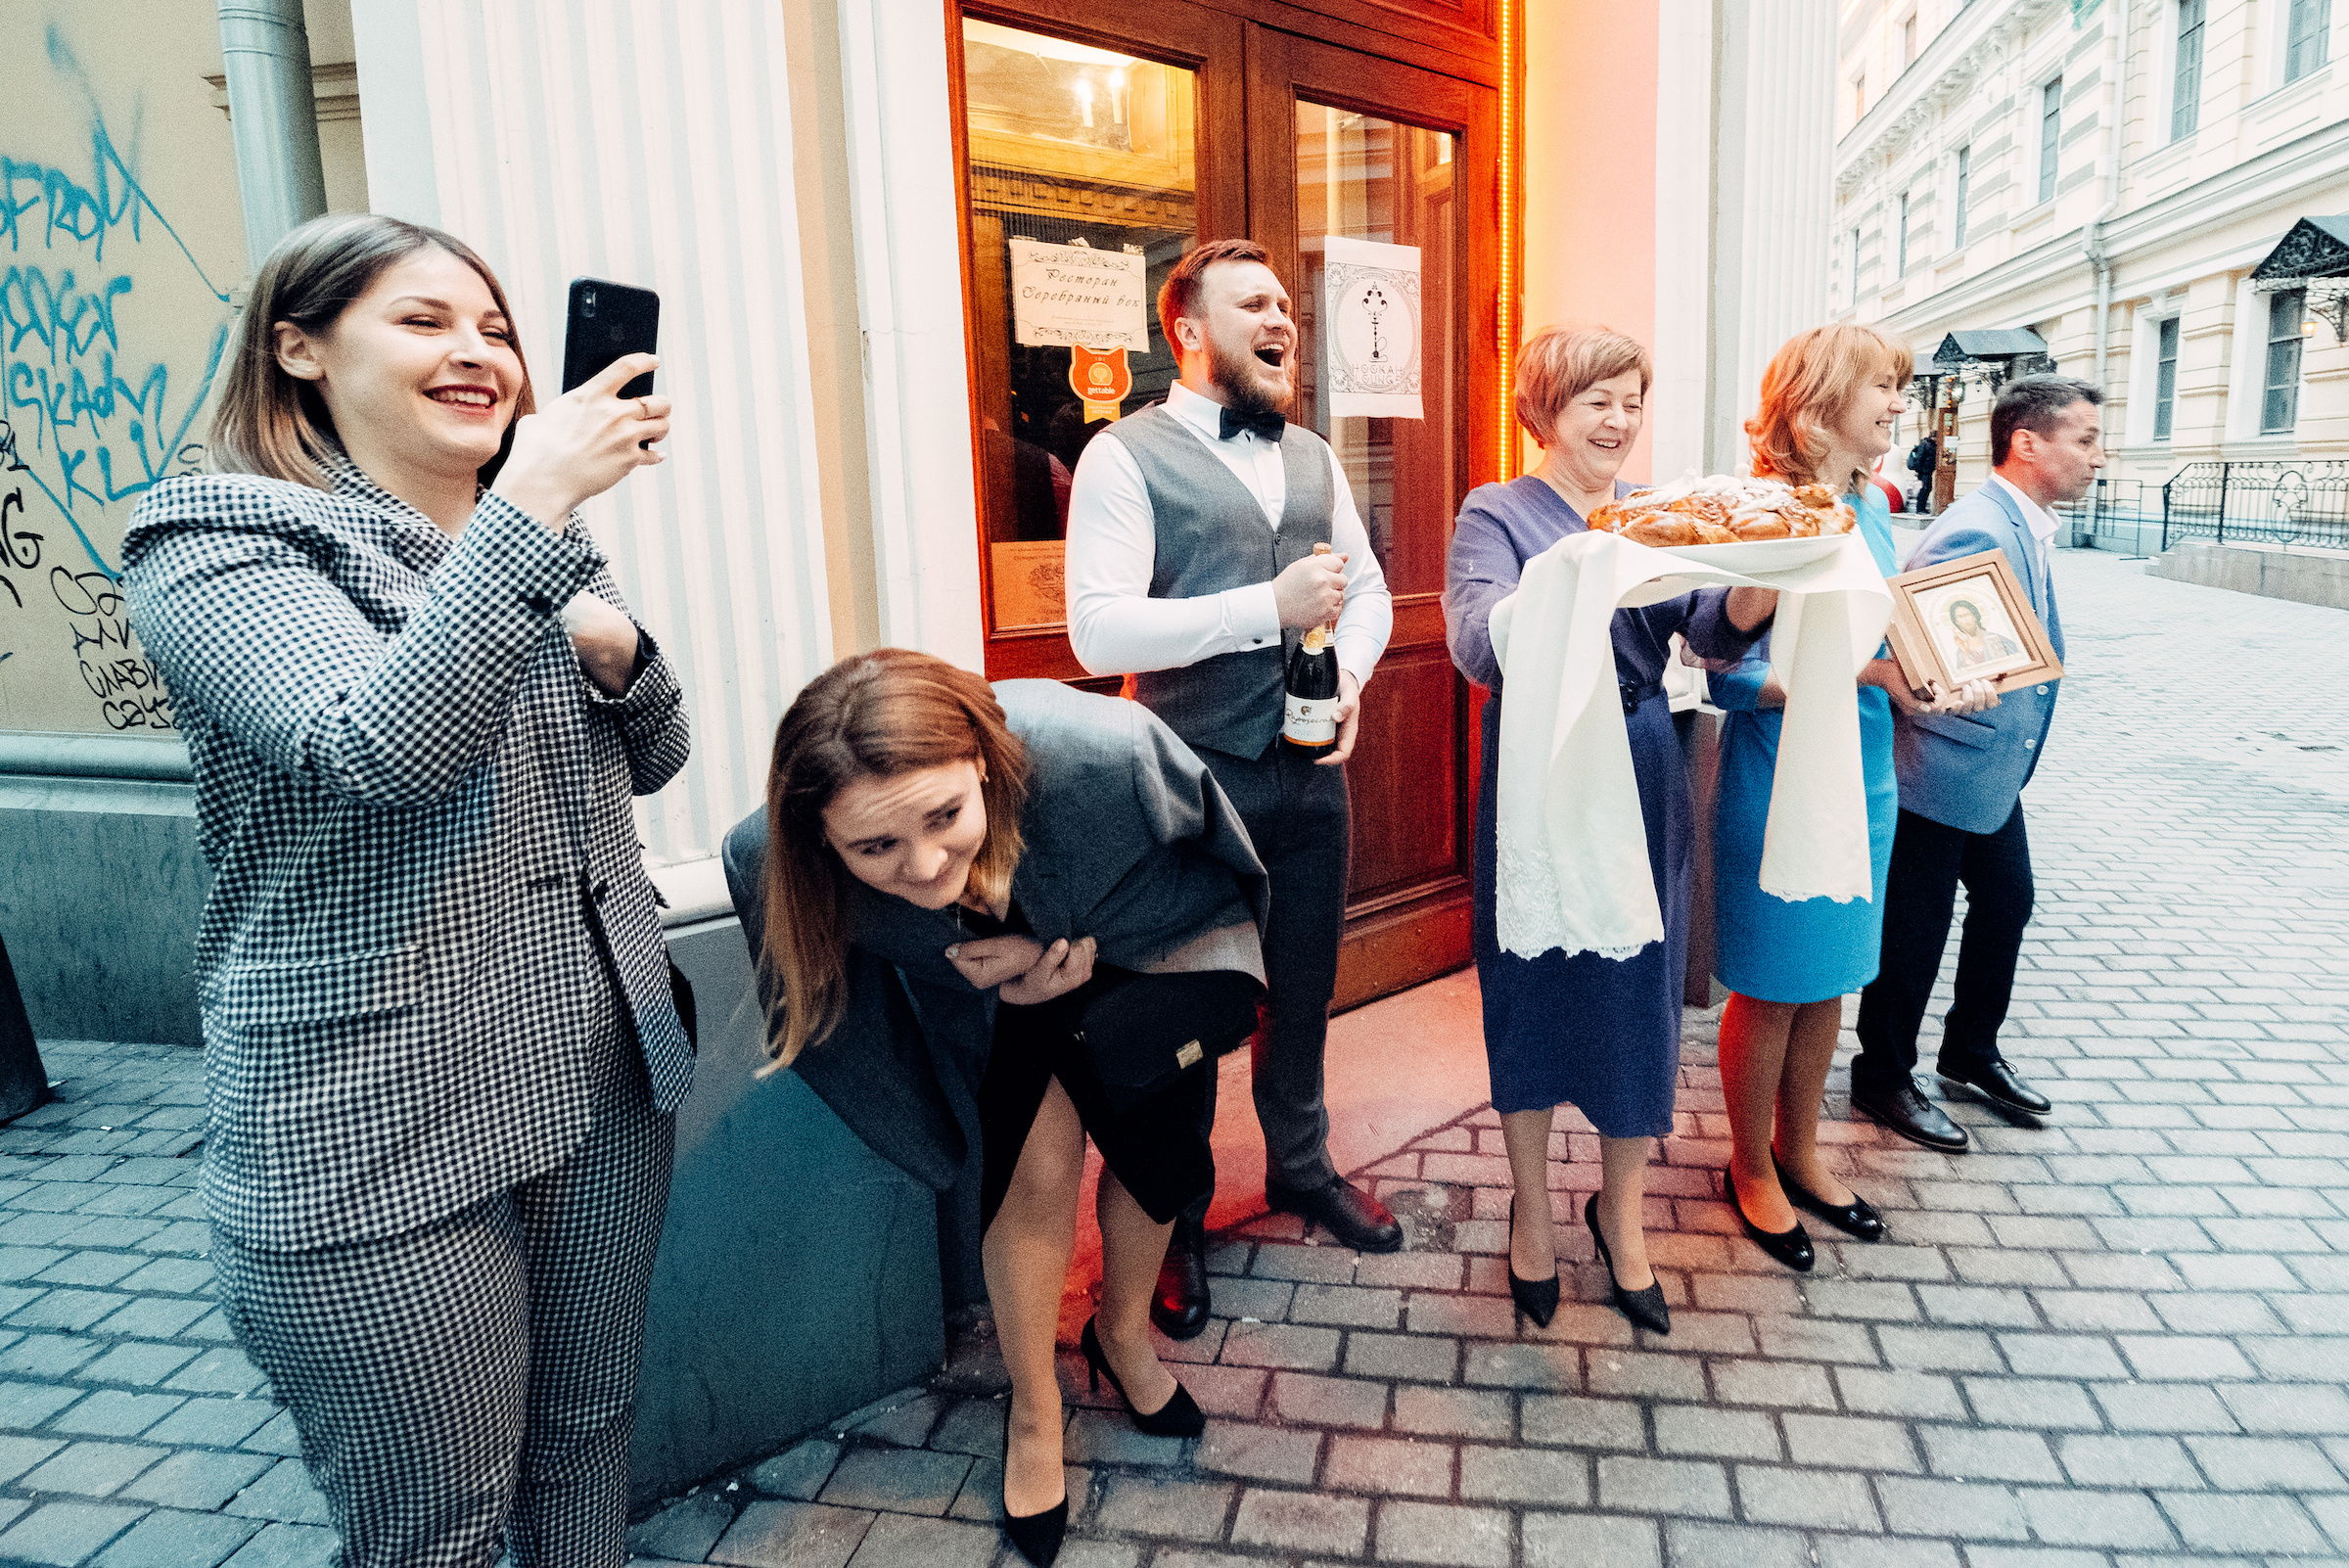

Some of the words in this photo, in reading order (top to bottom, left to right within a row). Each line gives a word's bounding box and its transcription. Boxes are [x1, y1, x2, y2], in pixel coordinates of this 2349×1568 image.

[1045, 268, 1119, 289] Ресторан
[1022, 286, 1110, 305] Серебряный
[1353, 363, 1404, 375] HOOKAH
[1355, 374, 1401, 385] LOUNGE
[1087, 387, 1116, 395] gettable
